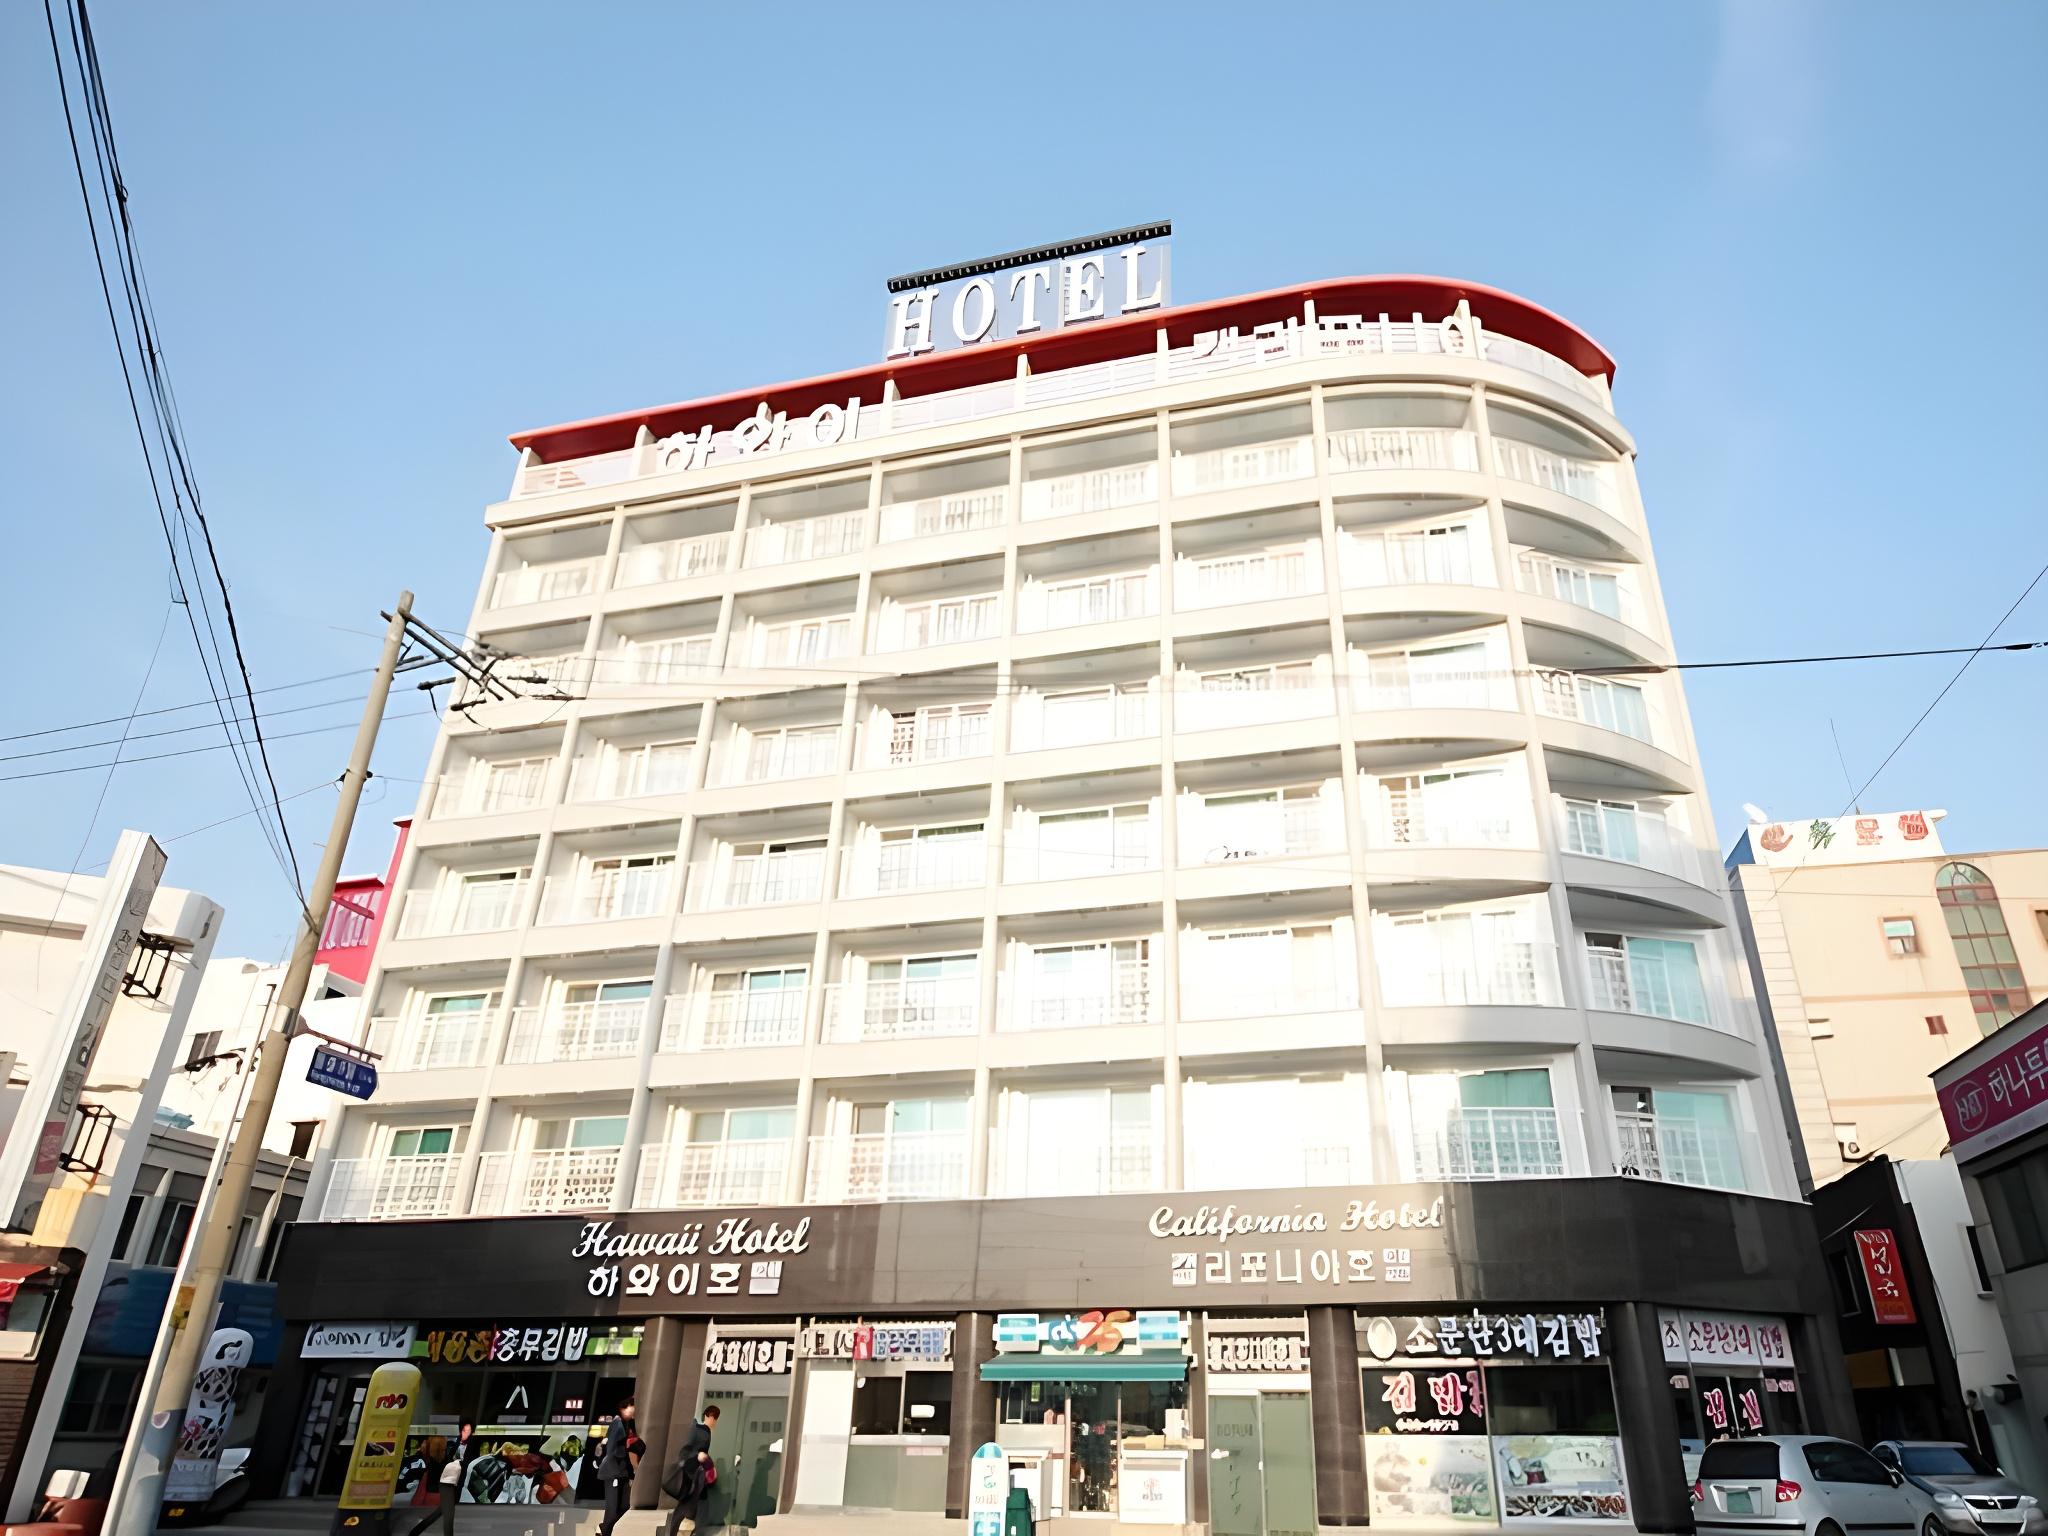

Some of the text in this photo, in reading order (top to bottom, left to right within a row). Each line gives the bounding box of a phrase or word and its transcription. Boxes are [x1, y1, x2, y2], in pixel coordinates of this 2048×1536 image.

[886, 244, 1163, 358] HOTEL
[1988, 1038, 2048, 1107] 하나투
[572, 1217, 810, 1257] Hawaii Hotel
[1149, 1195, 1444, 1243] California Hotel
